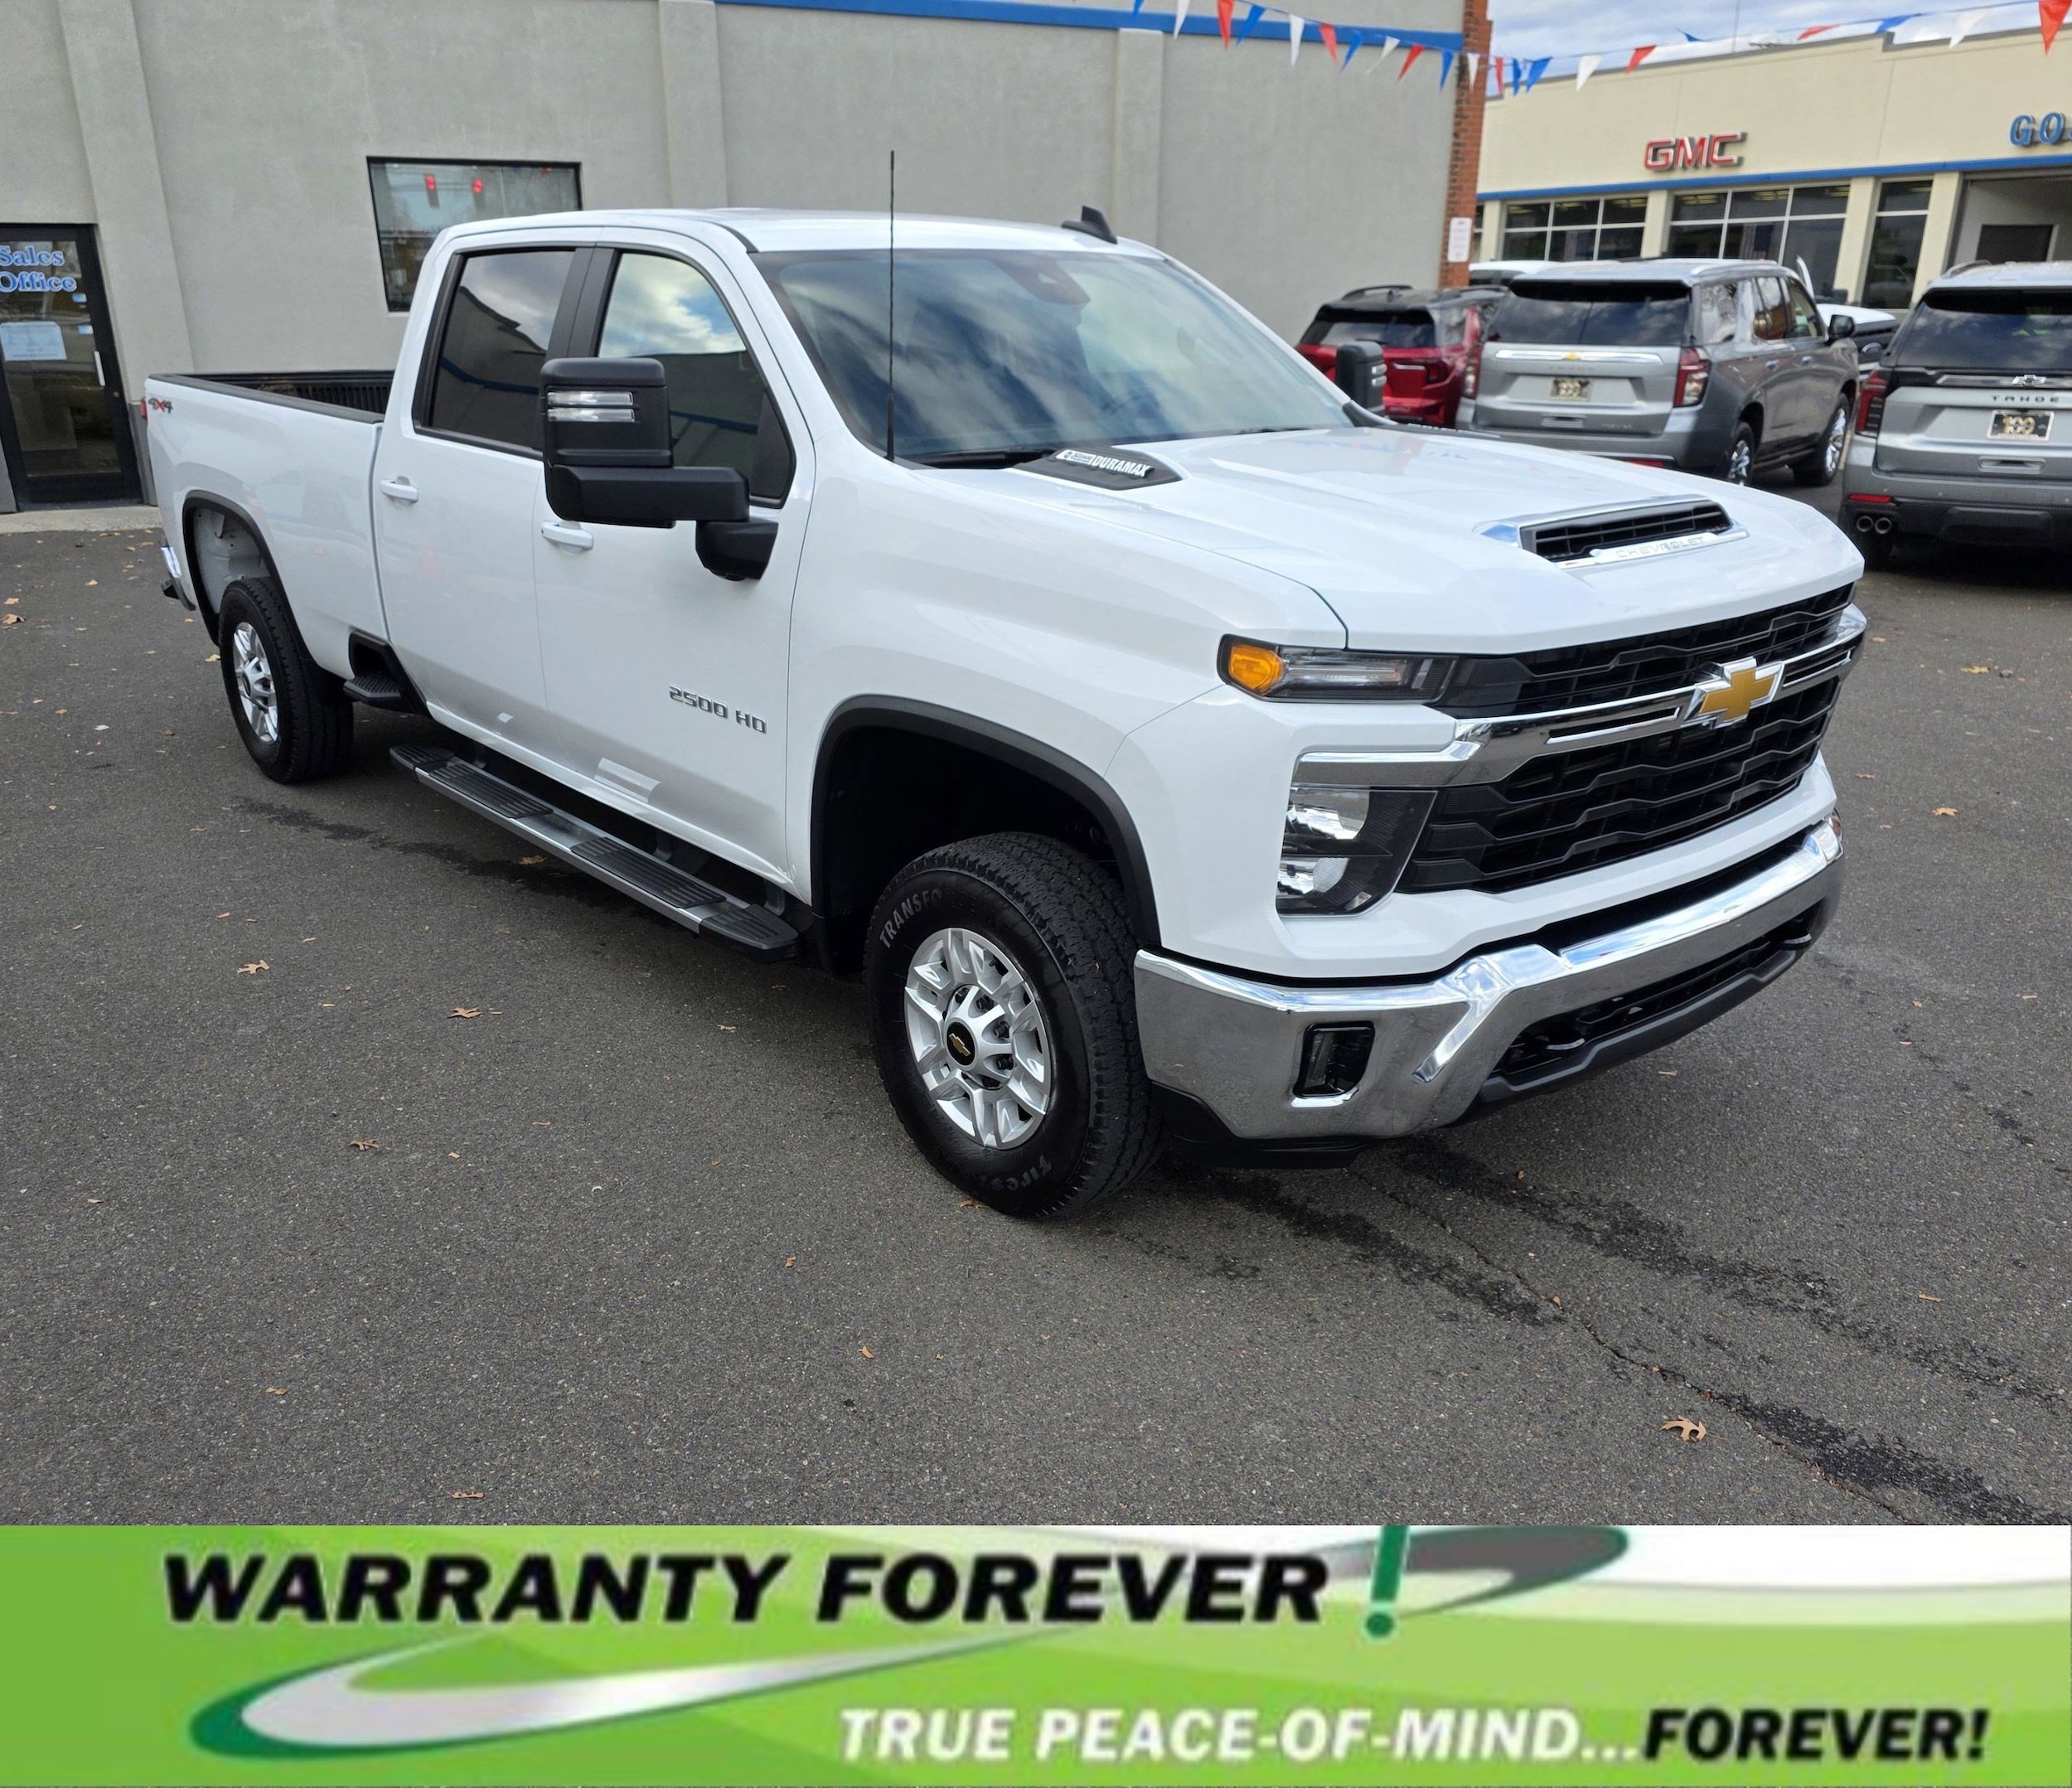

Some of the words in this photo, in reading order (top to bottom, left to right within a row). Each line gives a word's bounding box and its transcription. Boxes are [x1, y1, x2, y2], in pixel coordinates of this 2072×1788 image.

[2008, 111, 2072, 147] GO
[1644, 133, 1745, 170] GMC
[0, 245, 65, 267] Sales
[0, 271, 77, 292] Office
[1091, 455, 1150, 478] DURAMAX
[1616, 536, 1704, 558] CHEVROLET
[669, 685, 729, 720] 2500
[735, 708, 767, 734] HD
